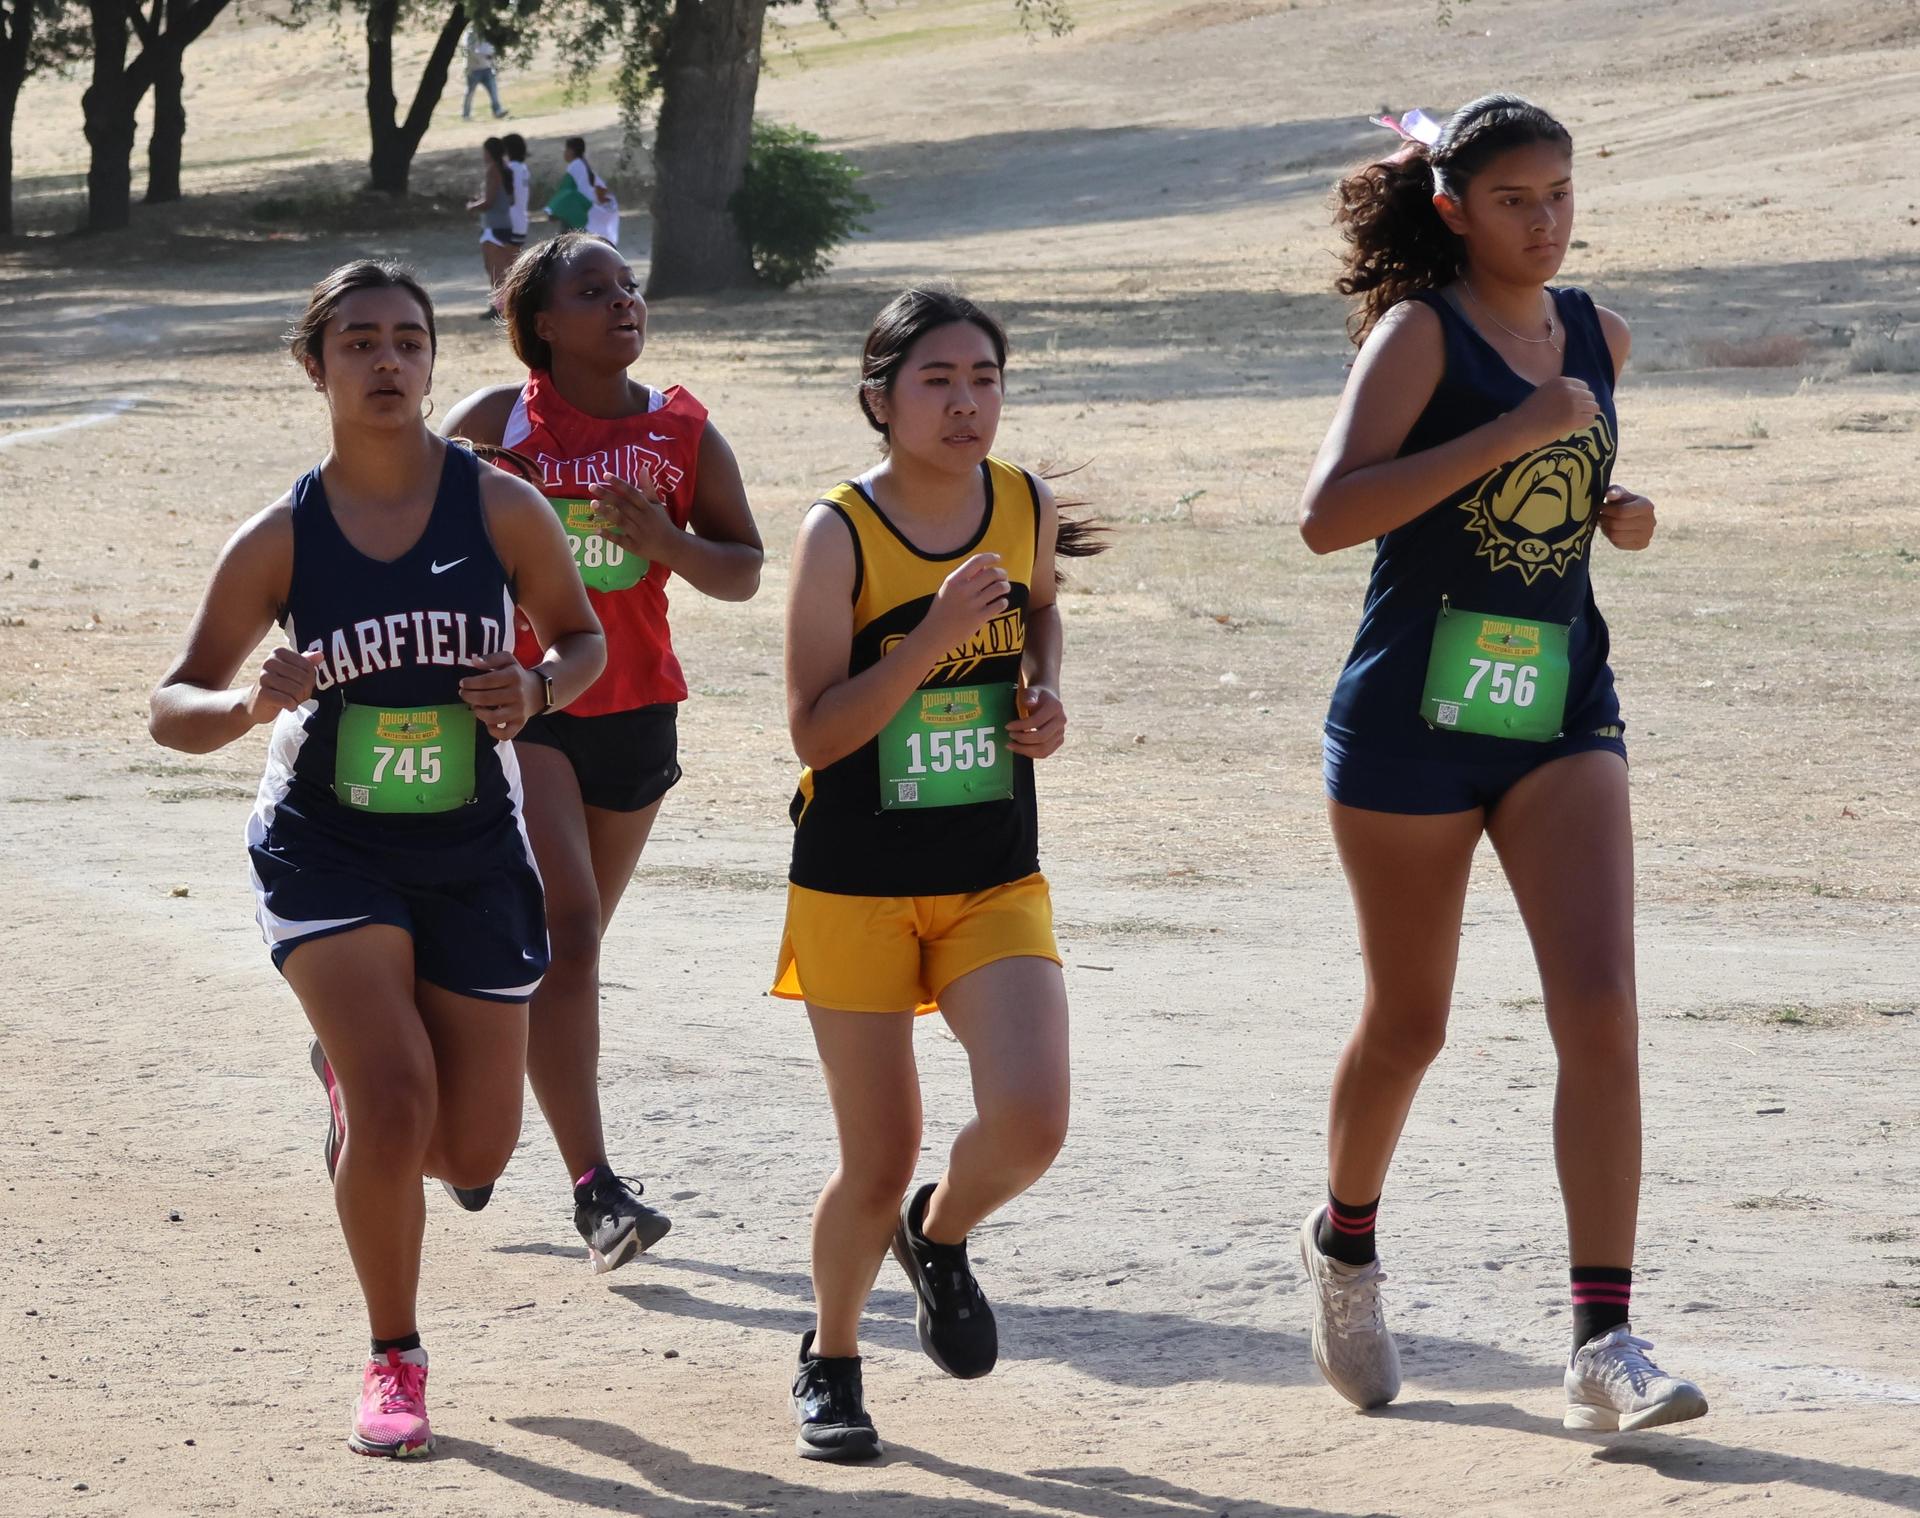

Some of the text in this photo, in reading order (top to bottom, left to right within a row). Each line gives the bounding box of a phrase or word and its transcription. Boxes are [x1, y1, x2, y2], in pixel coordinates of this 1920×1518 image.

[537, 445, 685, 506] TRIBE
[1521, 543, 1545, 558] GV
[307, 610, 500, 691] GARFIELD
[1481, 620, 1539, 643] ROUGH RIDER
[922, 690, 979, 709] ROUGH RIDER
[1463, 658, 1538, 707] 756
[379, 711, 438, 726] ROUGH RIDER
[372, 745, 442, 784] 745
[906, 726, 996, 774] 1555
